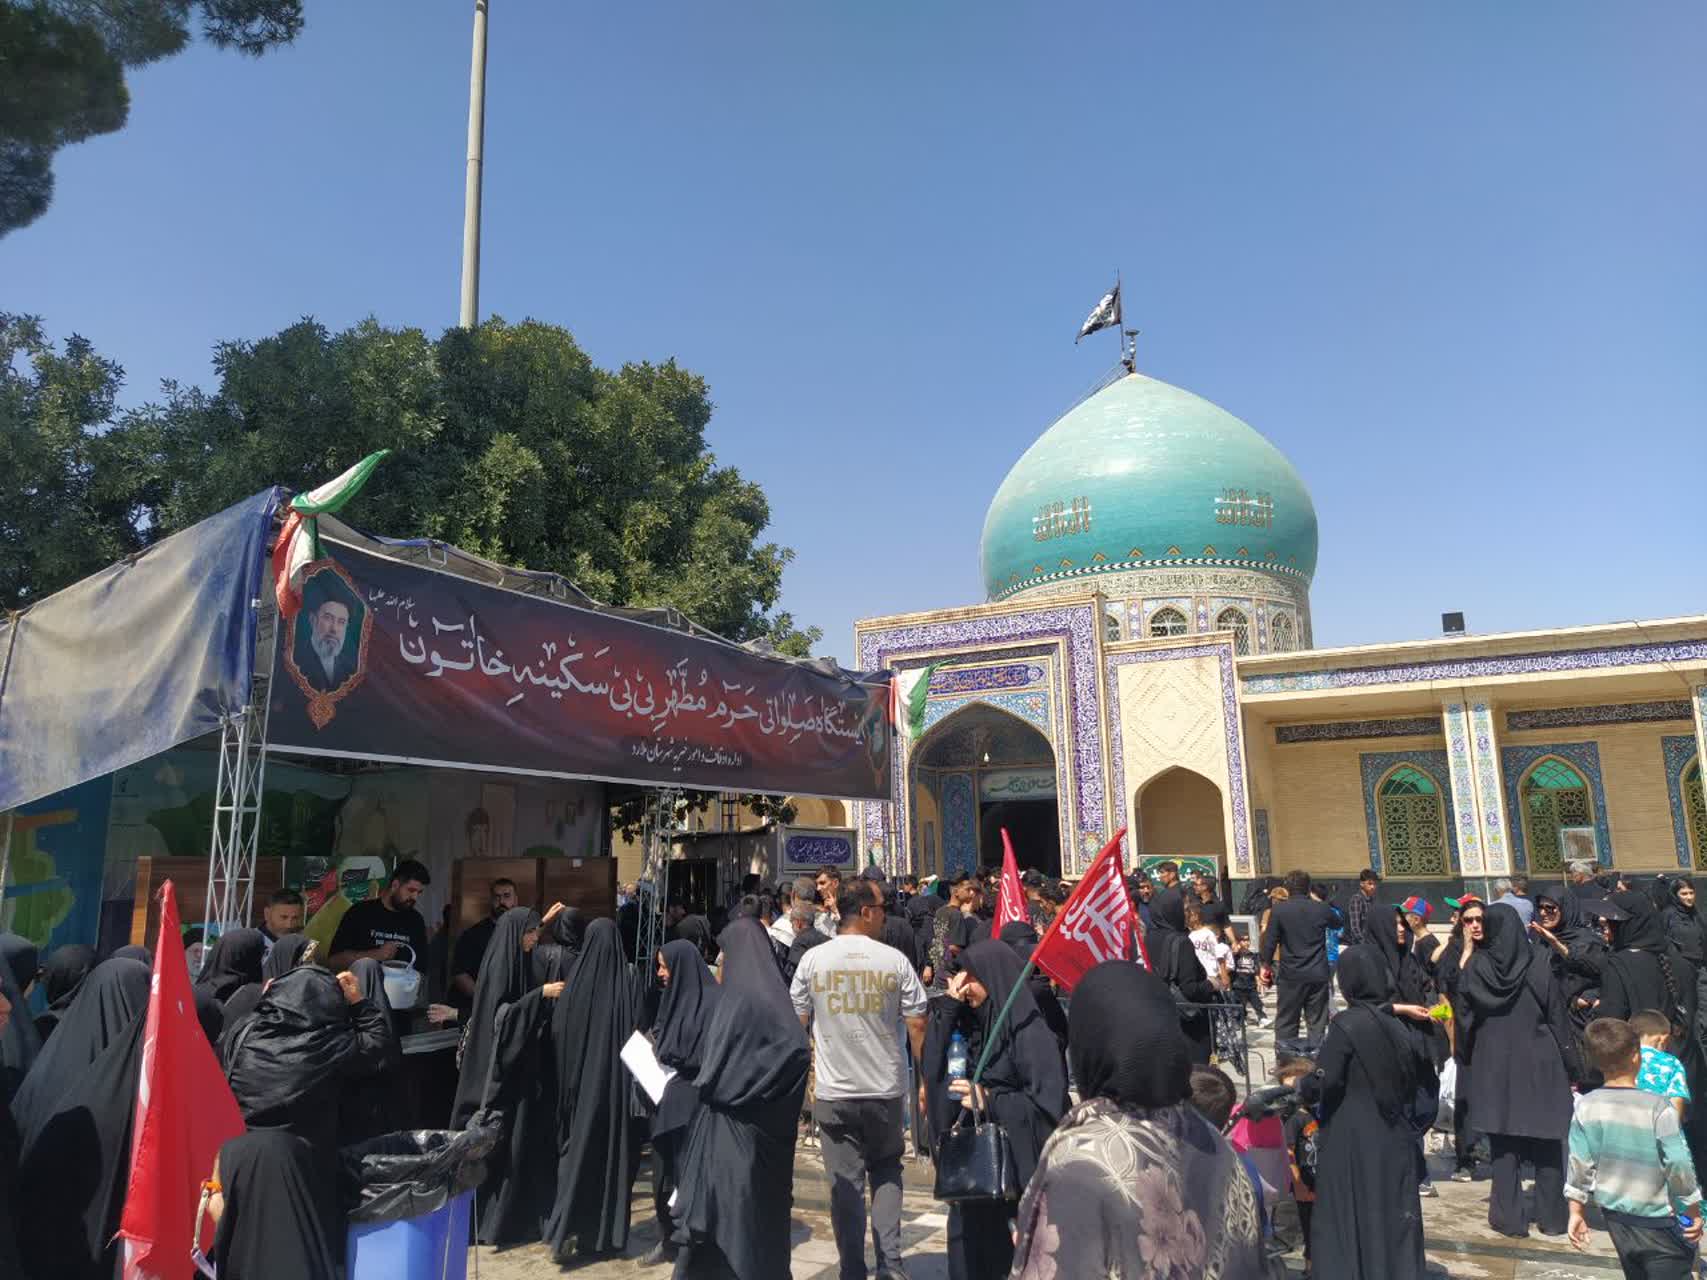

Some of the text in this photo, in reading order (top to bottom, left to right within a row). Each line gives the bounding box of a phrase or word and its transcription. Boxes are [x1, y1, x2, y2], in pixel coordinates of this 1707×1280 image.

[400, 615, 511, 677] خاتون
[812, 970, 898, 993] LIFTING
[827, 992, 885, 1014] CLUB
